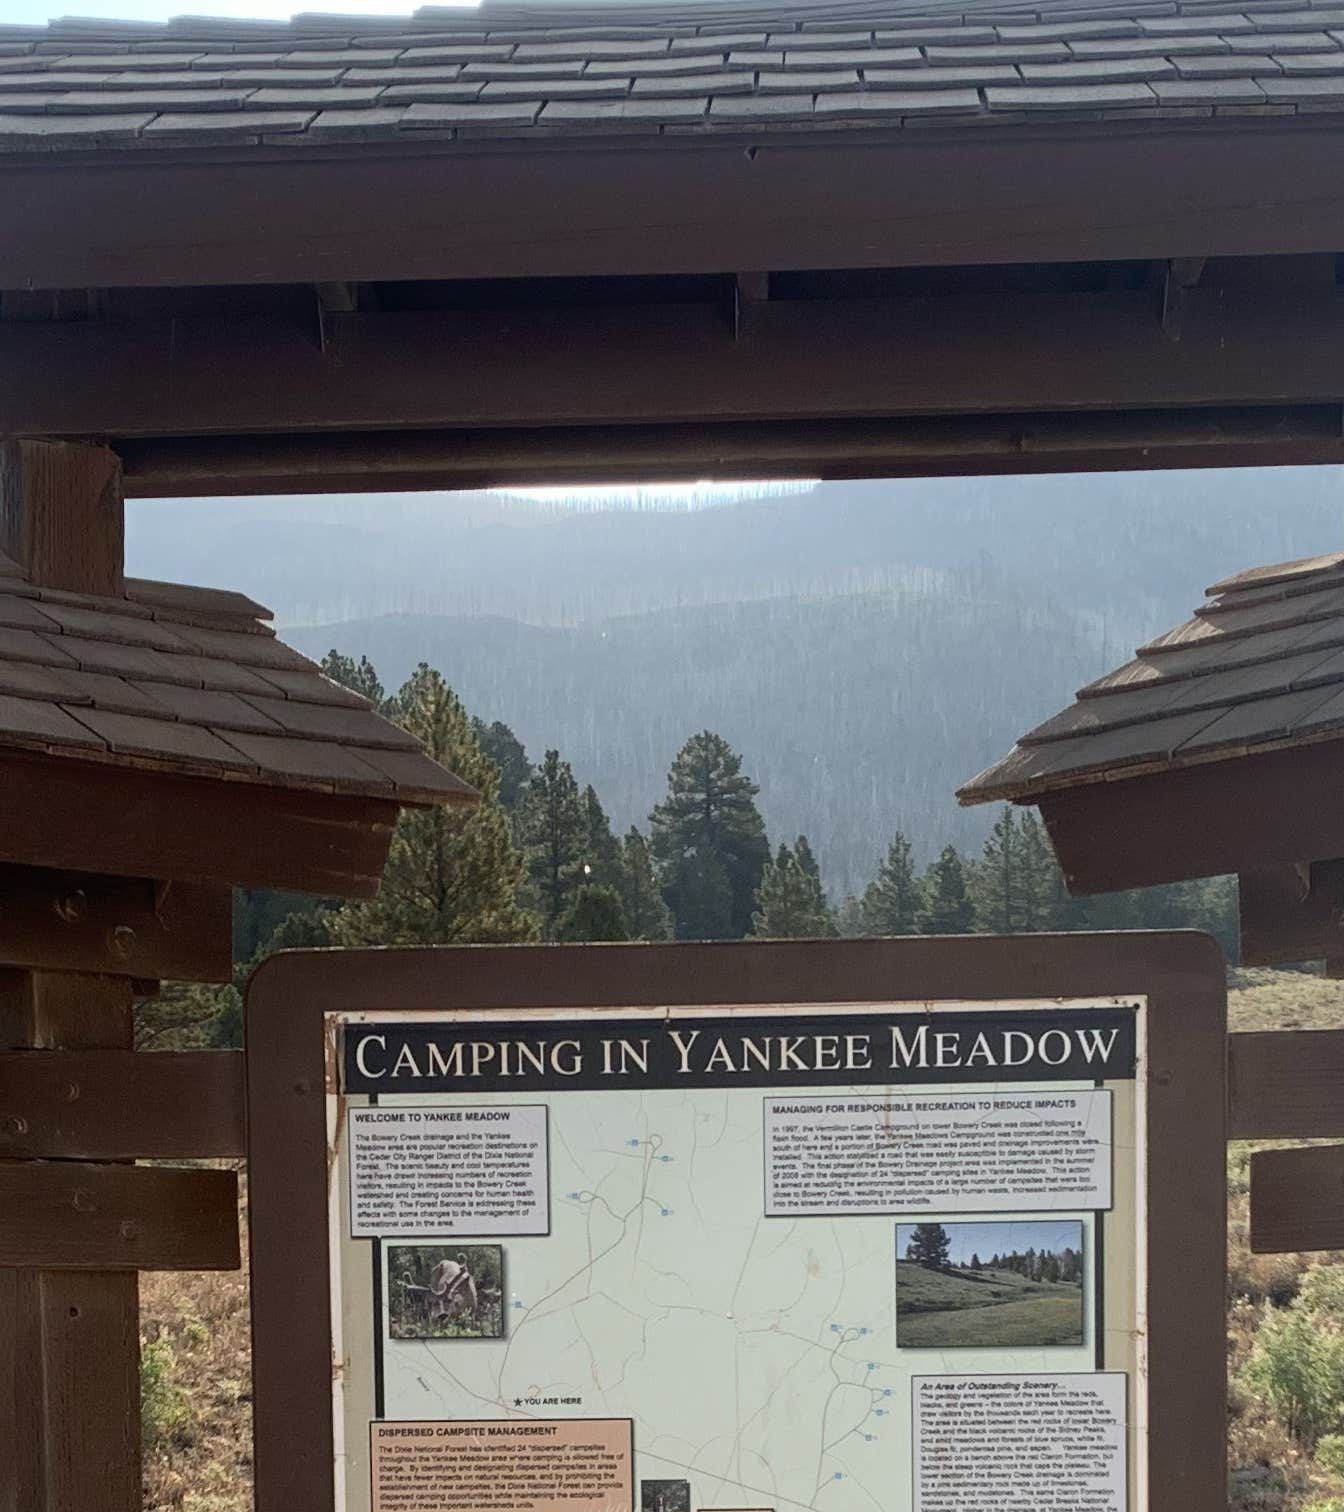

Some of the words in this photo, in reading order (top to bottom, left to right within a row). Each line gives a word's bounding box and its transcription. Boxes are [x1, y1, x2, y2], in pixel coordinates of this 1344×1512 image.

[356, 1035, 583, 1079] CAMPING
[600, 1039, 649, 1075] IN
[667, 1029, 872, 1074] YANKEE
[889, 1025, 1120, 1069] MEADOW
[772, 1105, 823, 1114] MANAGING
[825, 1104, 845, 1113] FOR
[847, 1103, 913, 1113] RESPONSIBLE
[915, 1102, 976, 1112] RECREATION
[978, 1101, 991, 1110] TO
[993, 1100, 1033, 1110] REDUCE
[1034, 1099, 1077, 1109] IMPACTS
[355, 1113, 405, 1123] WELCOME
[409, 1113, 422, 1122] TO
[424, 1112, 463, 1122] YANKEE
[465, 1112, 510, 1121] MEADOW
[524, 1397, 541, 1406] YOU
[542, 1397, 558, 1406] ARE
[560, 1397, 582, 1405] HERE
[378, 1428, 434, 1437] DISPERSED
[436, 1427, 485, 1437] CAMPSITE
[488, 1426, 558, 1436] MANAGEMENT
